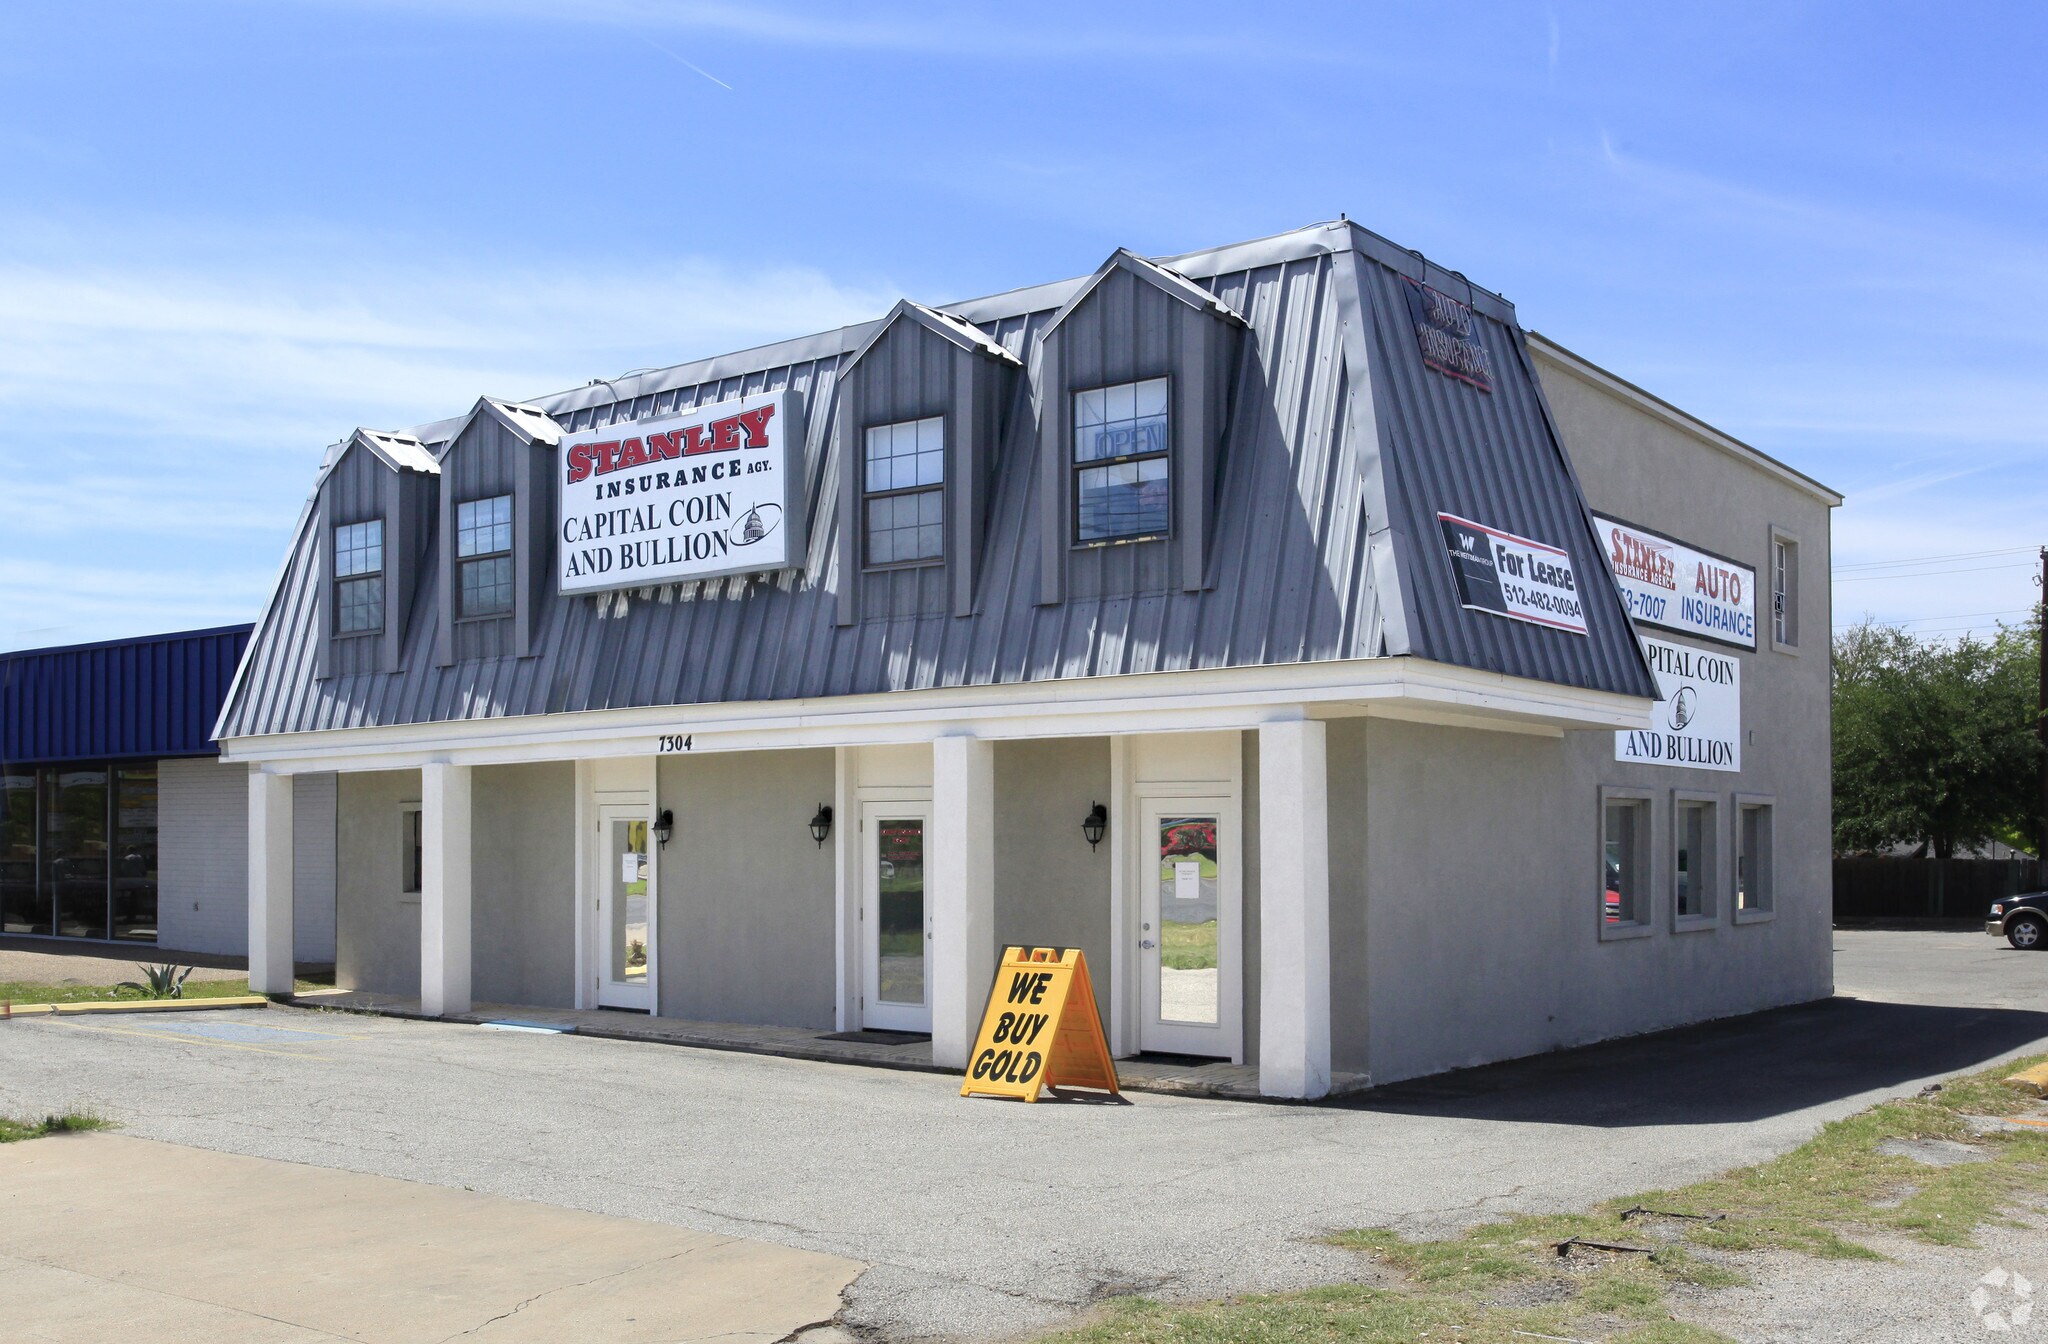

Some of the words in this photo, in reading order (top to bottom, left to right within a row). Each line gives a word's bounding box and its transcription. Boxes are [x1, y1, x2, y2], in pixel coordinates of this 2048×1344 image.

[567, 403, 775, 485] STANLEY
[1097, 422, 1166, 458] OPEN
[596, 459, 741, 500] INSURANCE
[747, 460, 772, 475] AGY.
[563, 504, 662, 543] CAPITAL
[668, 492, 732, 527] COIN
[565, 547, 613, 578] AND
[619, 529, 729, 570] BULLION
[1496, 544, 1525, 579] For
[1527, 553, 1575, 592] Lease
[1611, 528, 1675, 578] STANLEY
[1650, 571, 1674, 589] AGENCY
[1695, 561, 1742, 606] AUTO
[1503, 582, 1583, 619] 512-482-0094
[1681, 596, 1753, 638] INSURANCE
[1697, 656, 1734, 686] COIN
[659, 735, 692, 752] 7304
[1625, 730, 1662, 759] AND
[1666, 734, 1733, 766] BULLION
[1007, 972, 1053, 1005] WE
[992, 1012, 1049, 1046] BUY
[972, 1048, 1042, 1084] GOLD
